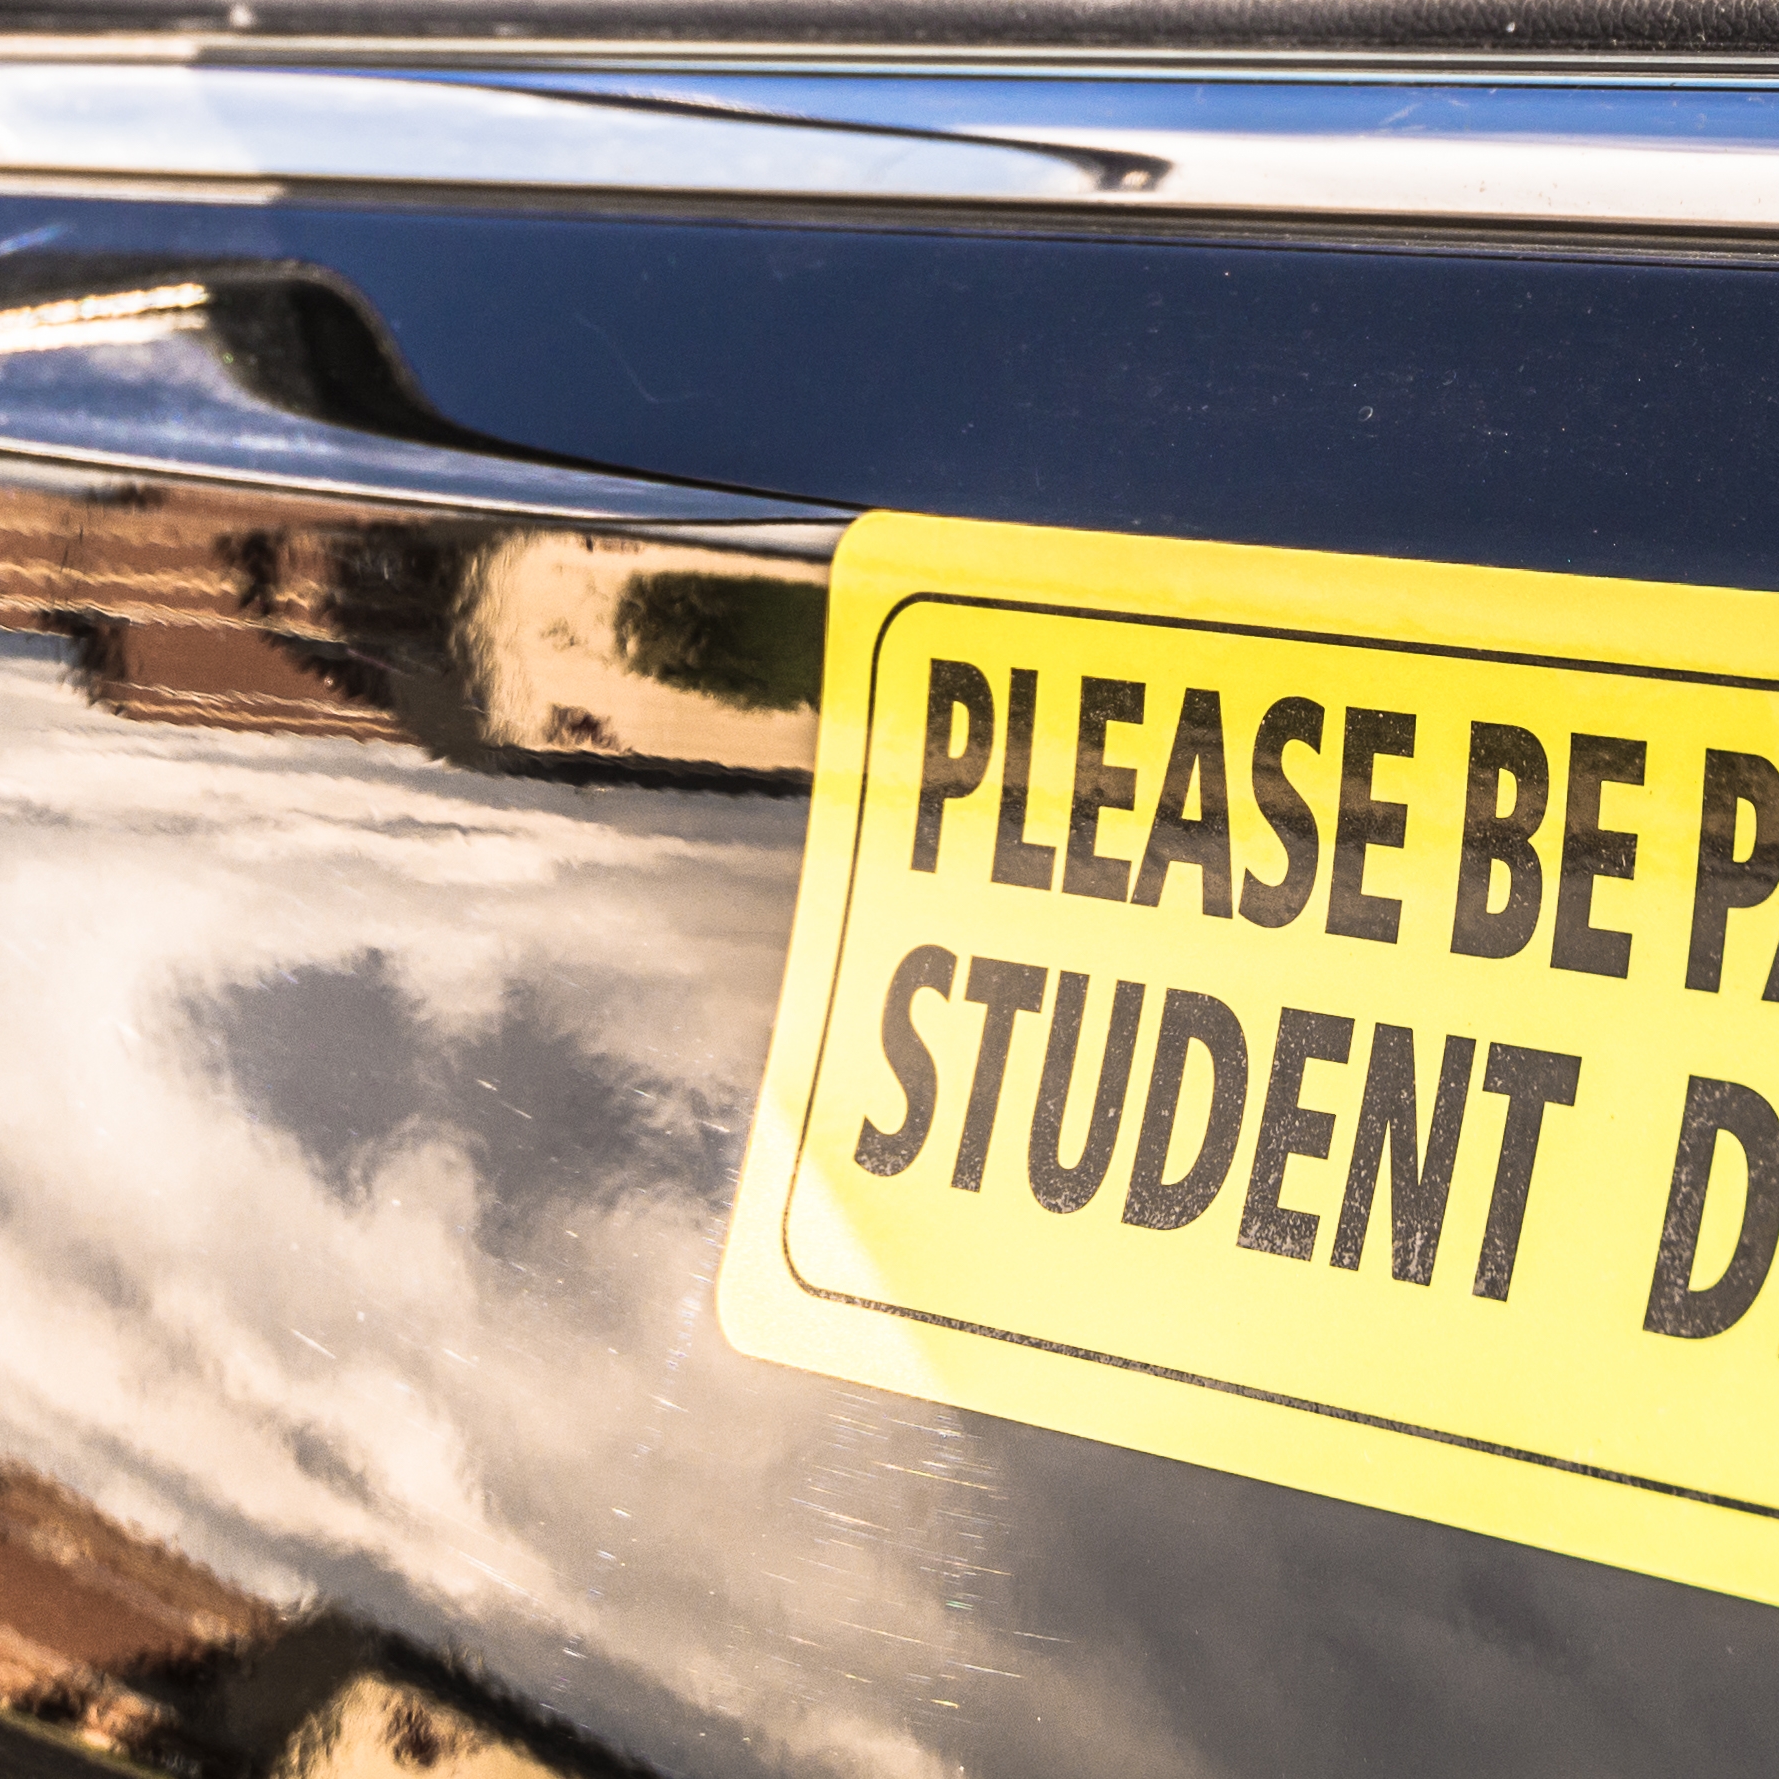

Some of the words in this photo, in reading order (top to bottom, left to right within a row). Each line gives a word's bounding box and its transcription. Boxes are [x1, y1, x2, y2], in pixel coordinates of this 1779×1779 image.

[910, 656, 1417, 946] PLEASE
[1448, 719, 1649, 981] BE
[852, 944, 1583, 1304] STUDENT
